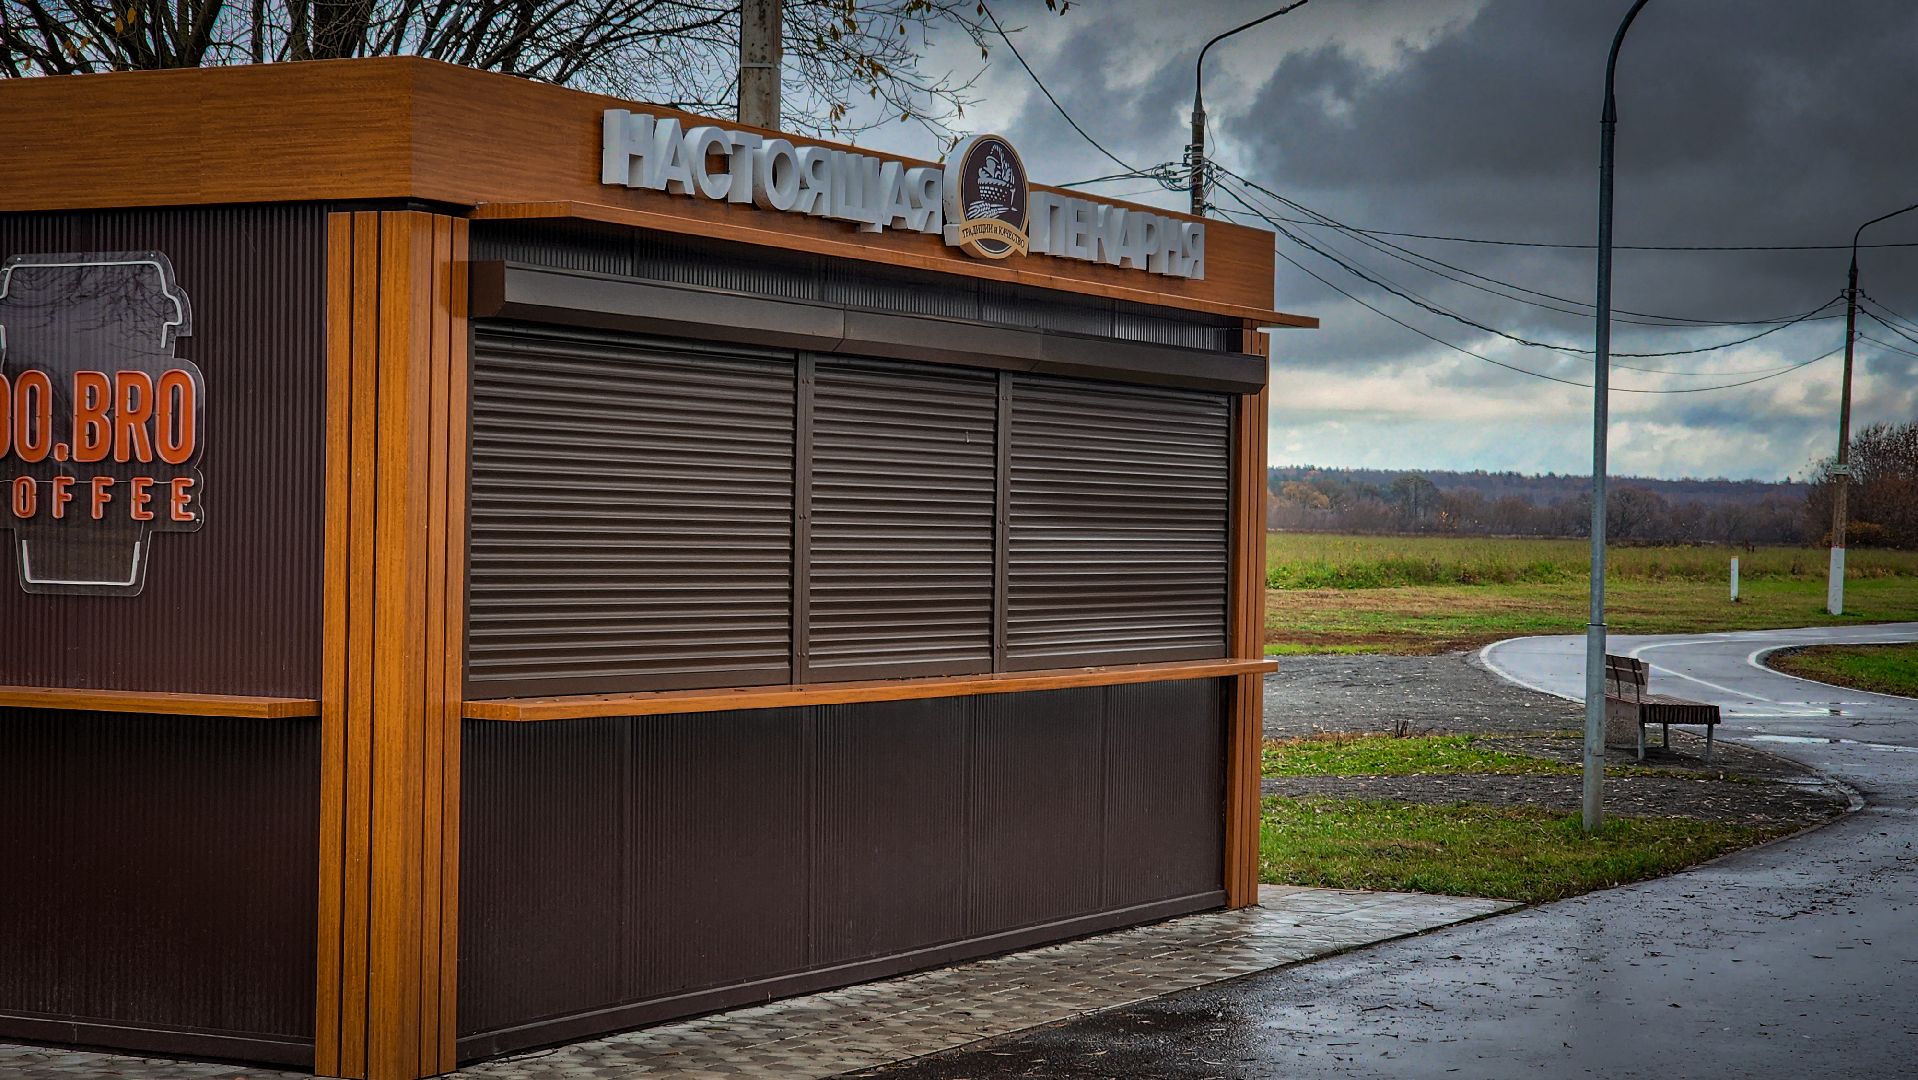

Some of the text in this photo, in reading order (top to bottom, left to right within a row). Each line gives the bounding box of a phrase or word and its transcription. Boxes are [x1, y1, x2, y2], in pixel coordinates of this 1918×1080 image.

[601, 108, 1205, 280] НАСТОЯЩАЯ ПЕКАРНЯ
[0, 369, 196, 465] O.BRO
[12, 476, 195, 522] OFFEE
